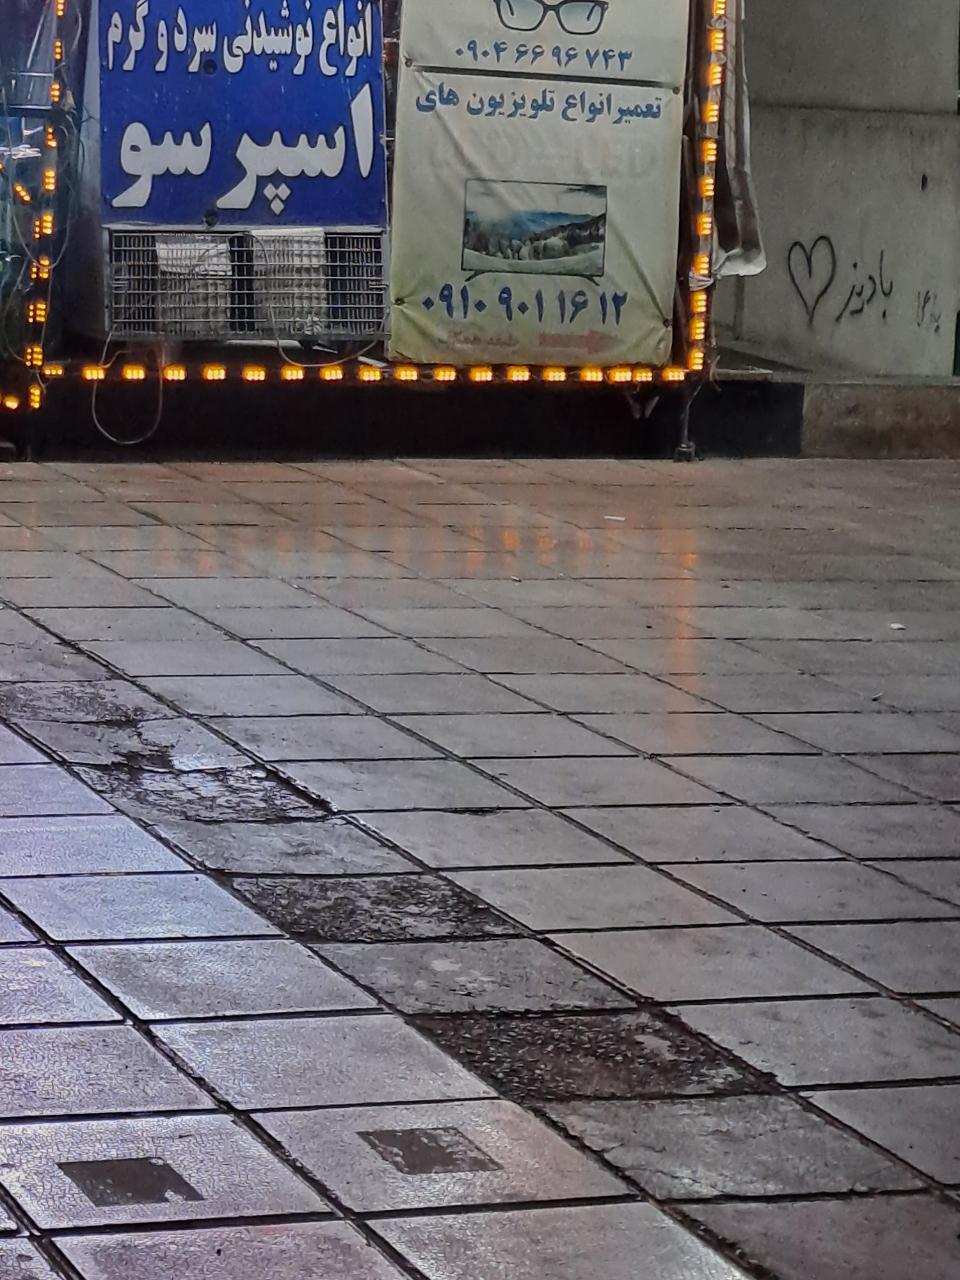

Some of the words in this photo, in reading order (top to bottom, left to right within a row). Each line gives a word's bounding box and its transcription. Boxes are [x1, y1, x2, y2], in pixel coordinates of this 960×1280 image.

[154, 18, 169, 73] و
[172, 4, 218, 74] سرد
[415, 81, 461, 114] های
[465, 86, 556, 119] تلویزیون
[560, 90, 613, 124] انواع
[611, 95, 663, 125] تعمیر
